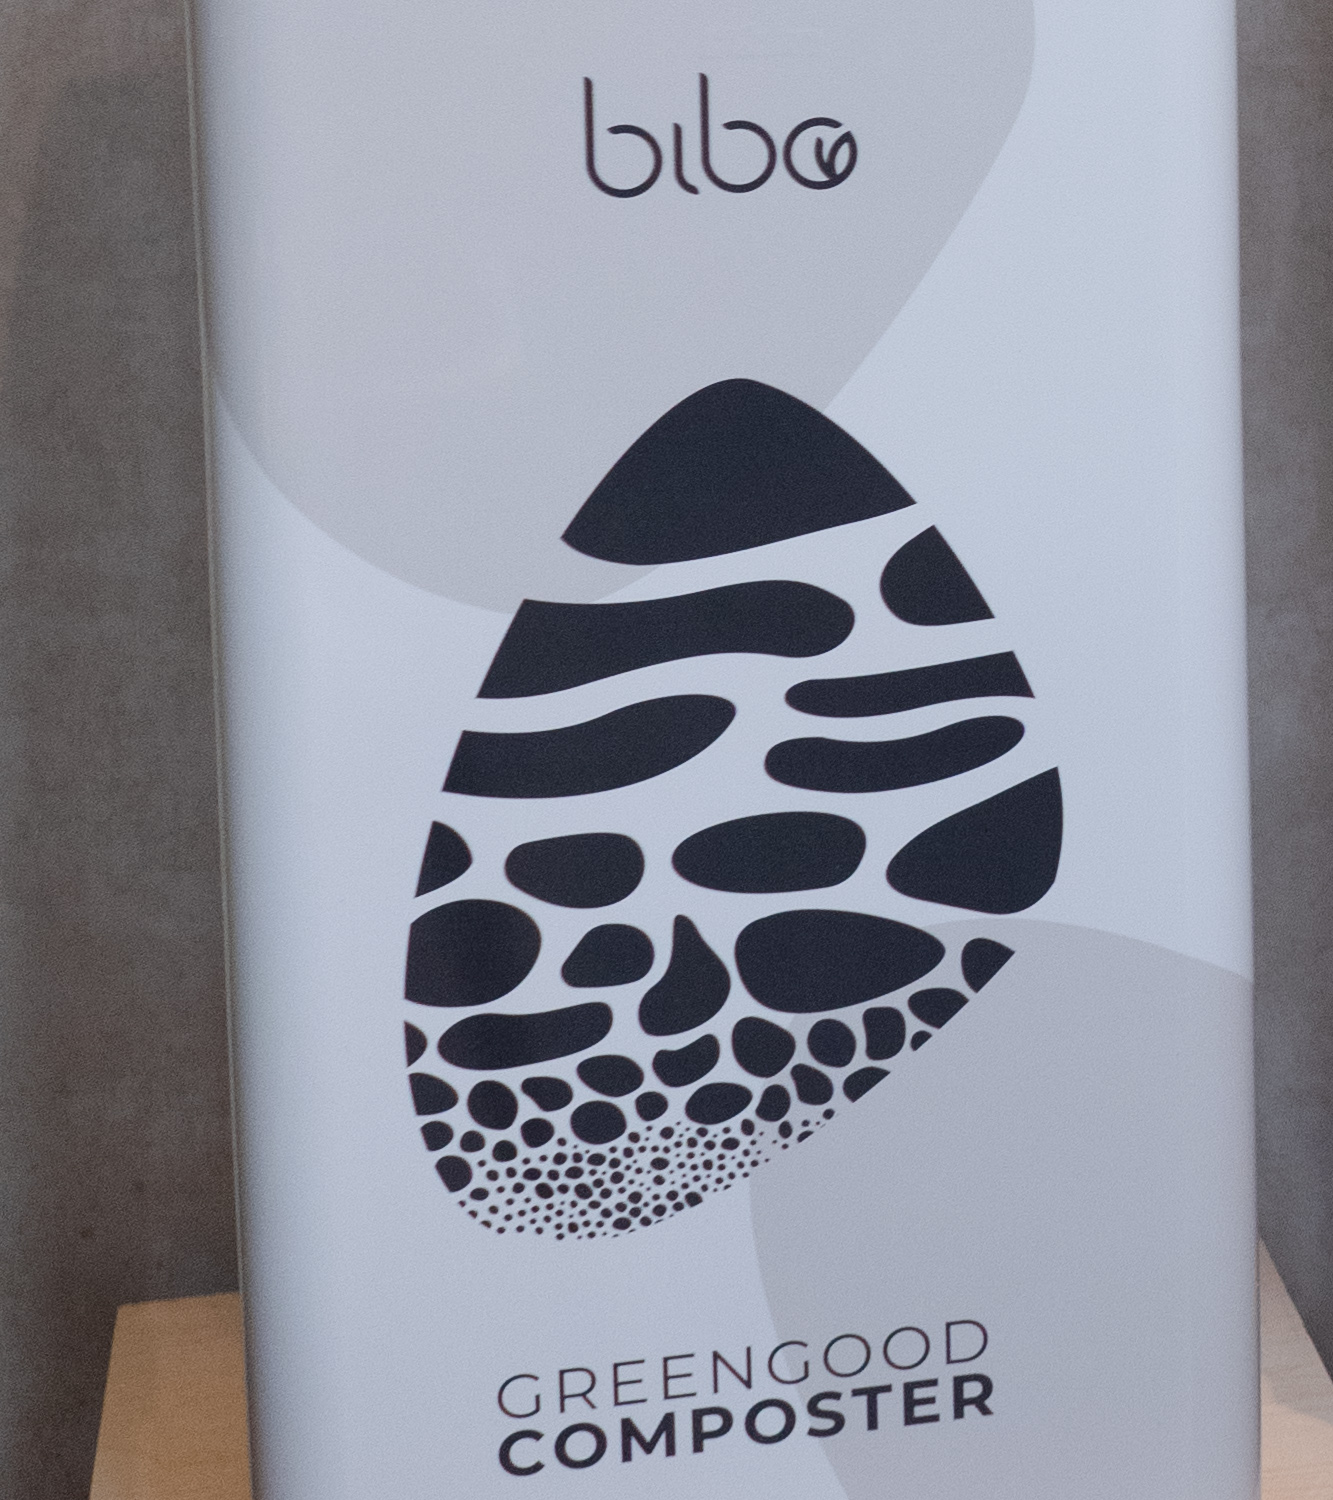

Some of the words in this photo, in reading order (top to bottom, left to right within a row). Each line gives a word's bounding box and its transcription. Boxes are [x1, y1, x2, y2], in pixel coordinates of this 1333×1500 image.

[583, 72, 859, 199] bibo
[497, 1319, 989, 1419] GREENGOOD
[498, 1373, 995, 1477] COMPOSTER
